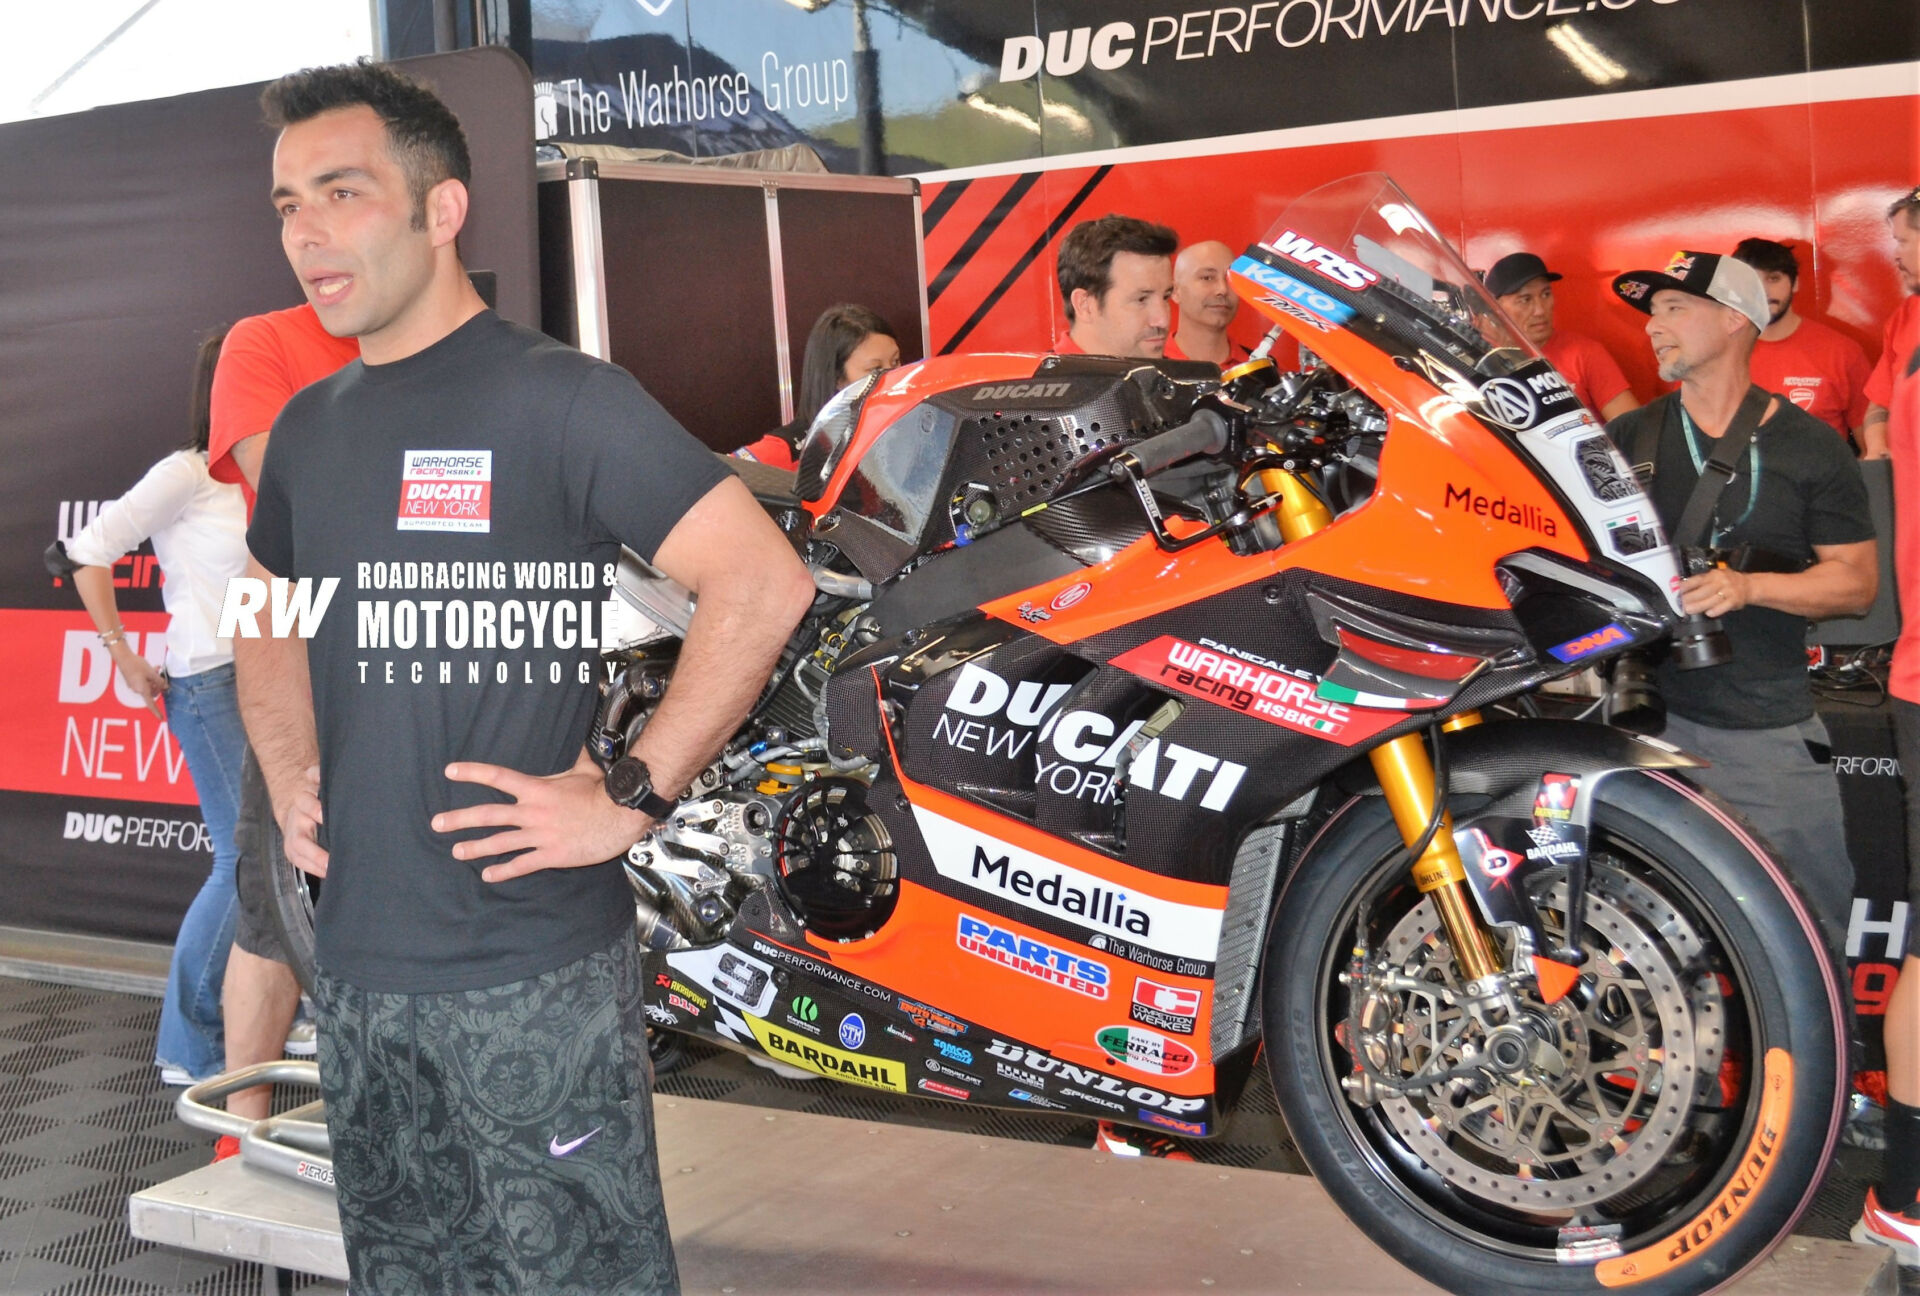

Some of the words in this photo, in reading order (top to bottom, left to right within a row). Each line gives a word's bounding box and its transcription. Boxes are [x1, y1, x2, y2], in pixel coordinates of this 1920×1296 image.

[562, 79, 611, 137] The
[618, 68, 750, 129] Warhorse
[761, 50, 849, 114] Group
[1271, 229, 1377, 288] WRS
[1242, 263, 1336, 312] KATO
[972, 383, 1071, 401] DUCATI
[410, 468, 445, 477] racing
[412, 456, 485, 468] WARHORSE
[404, 500, 440, 515] NEW
[441, 500, 482, 516] YORK
[406, 483, 483, 501] DUCATI
[1444, 482, 1558, 538] Medallia
[1199, 637, 1311, 681] PANIGALE
[1160, 663, 1254, 711] racing
[1254, 698, 1315, 728] HSBK
[932, 713, 1032, 760] NEW
[945, 662, 1248, 812] DUCATI
[63, 811, 215, 853] DUCPERFOR
[1526, 842, 1580, 865] BARDAHL
[971, 845, 1150, 937] Medallia
[752, 940, 891, 1003] DUCPERFORMANCE.COM
[960, 917, 1107, 985] PARTS
[960, 936, 1106, 998] UNLIMITED
[1107, 938, 1125, 957] The
[1129, 945, 1174, 972] Warhorse
[1177, 958, 1207, 976] Group
[842, 1025, 862, 1043] STM
[1132, 1004, 1193, 1024] COMPETITION
[768, 1032, 897, 1086] BARDAHL
[933, 1038, 972, 1057] SAMCO
[1102, 1034, 1189, 1063] FERRACCI
[984, 1039, 1205, 1114] DUNLOP
[1668, 1124, 1777, 1252] DUNLOP
